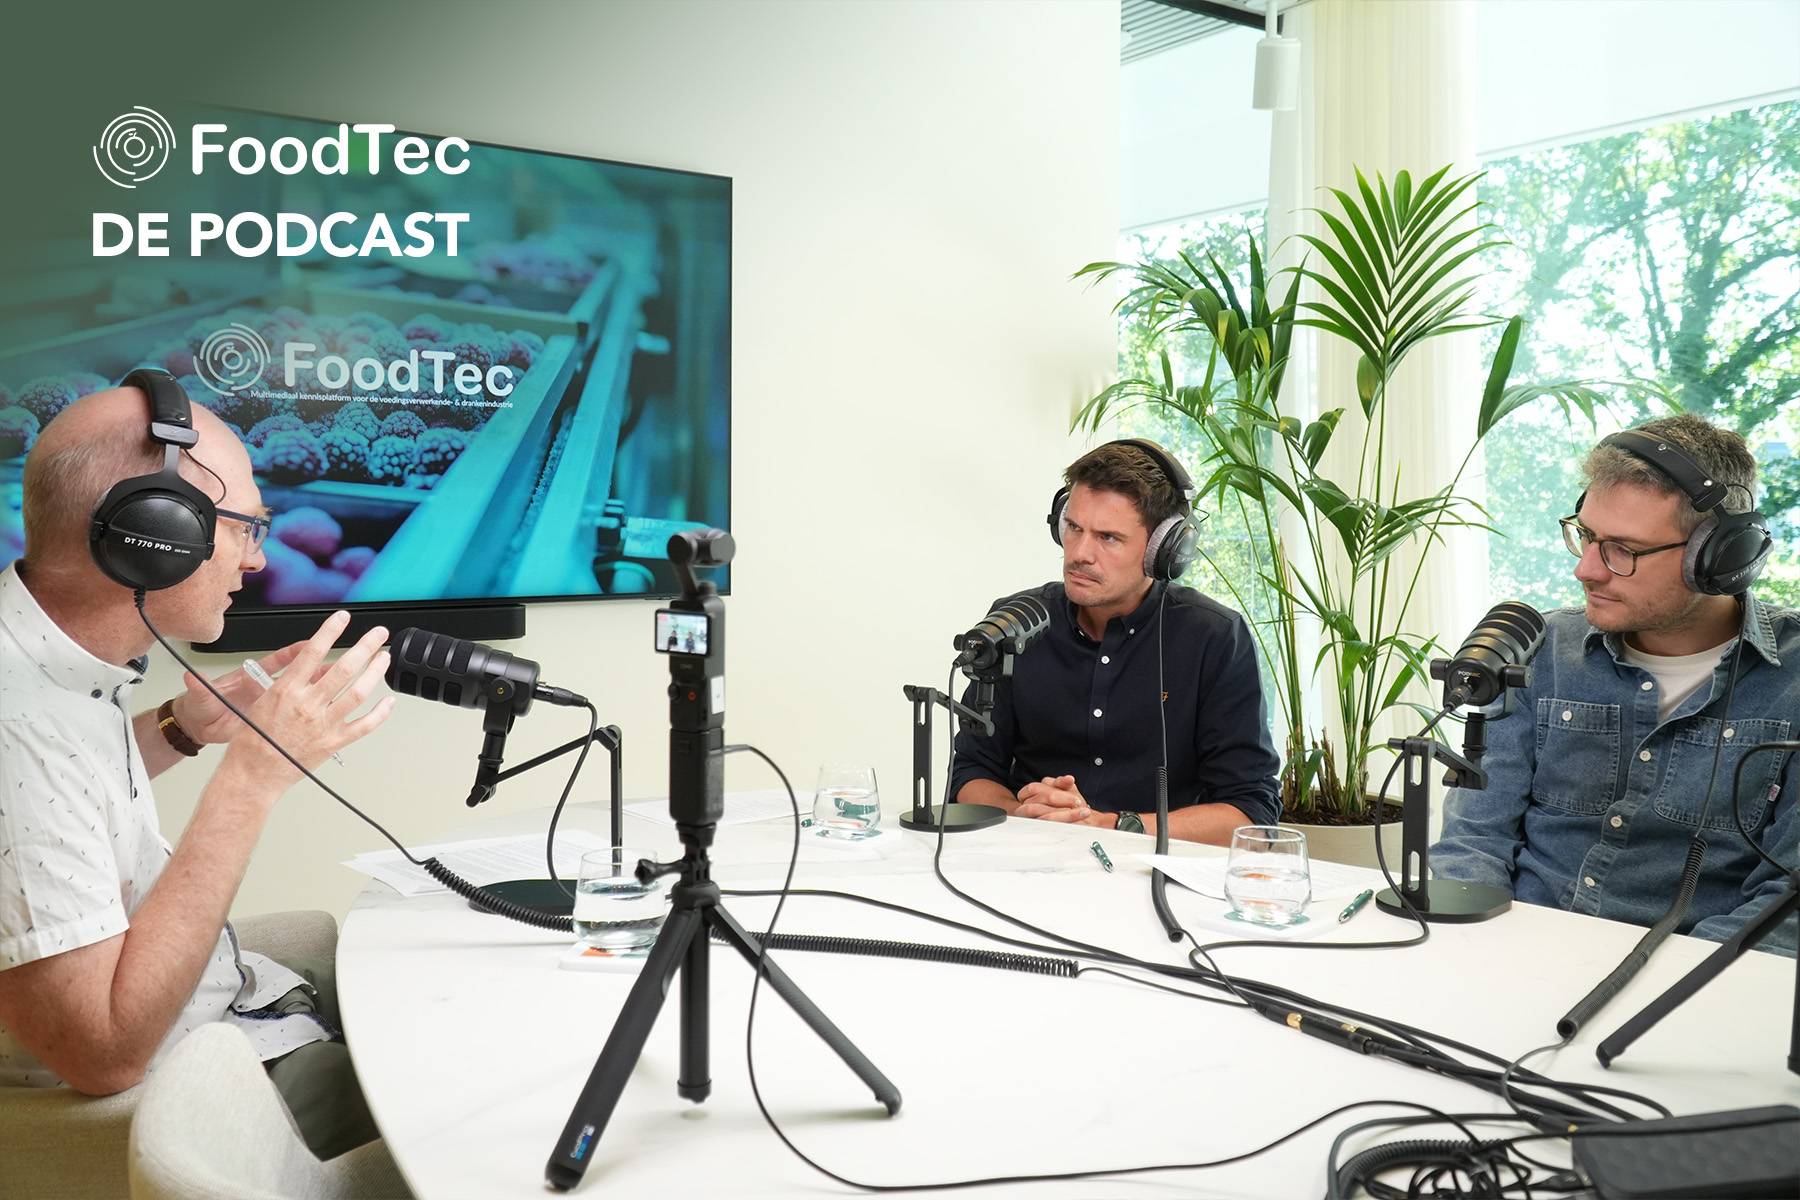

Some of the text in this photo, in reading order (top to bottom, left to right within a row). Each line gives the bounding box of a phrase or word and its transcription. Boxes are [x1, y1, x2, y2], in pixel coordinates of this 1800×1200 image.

[284, 341, 514, 396] FoodTec
[250, 391, 298, 399] Multimediaal
[300, 393, 351, 402] kennisplatform
[370, 395, 378, 403] de
[380, 397, 453, 405] voedingsverwerkende-
[462, 399, 513, 408] drankenindustrie
[124, 537, 136, 545] DT
[137, 540, 153, 548] 770
[154, 543, 172, 551] PRO
